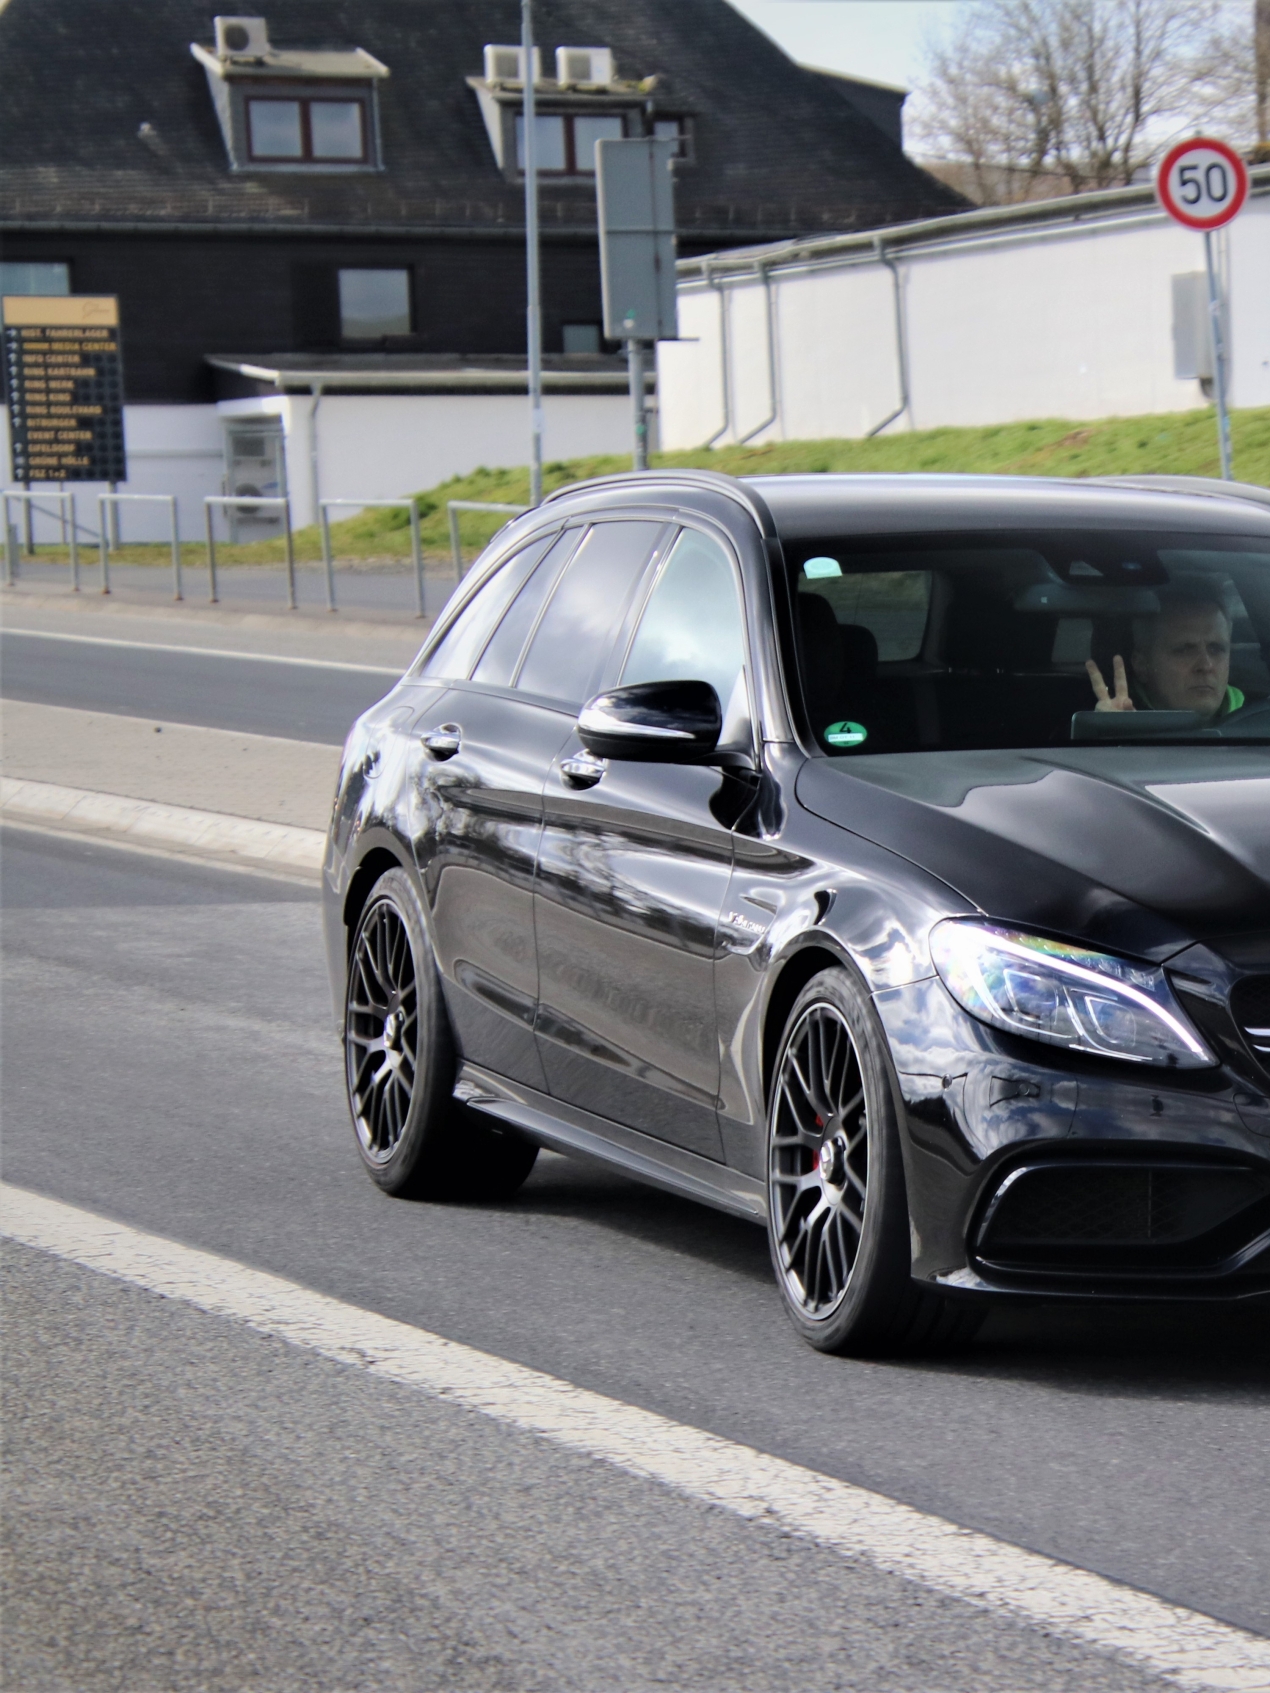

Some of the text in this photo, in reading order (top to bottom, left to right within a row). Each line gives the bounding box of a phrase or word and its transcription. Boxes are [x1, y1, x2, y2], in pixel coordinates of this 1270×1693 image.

[1179, 162, 1228, 204] 50
[51, 342, 80, 351] MEDIA
[82, 342, 117, 351] CENTER
[45, 354, 81, 363] CENTER
[27, 431, 93, 440] EVENT CENTER
[839, 722, 852, 733] 4
